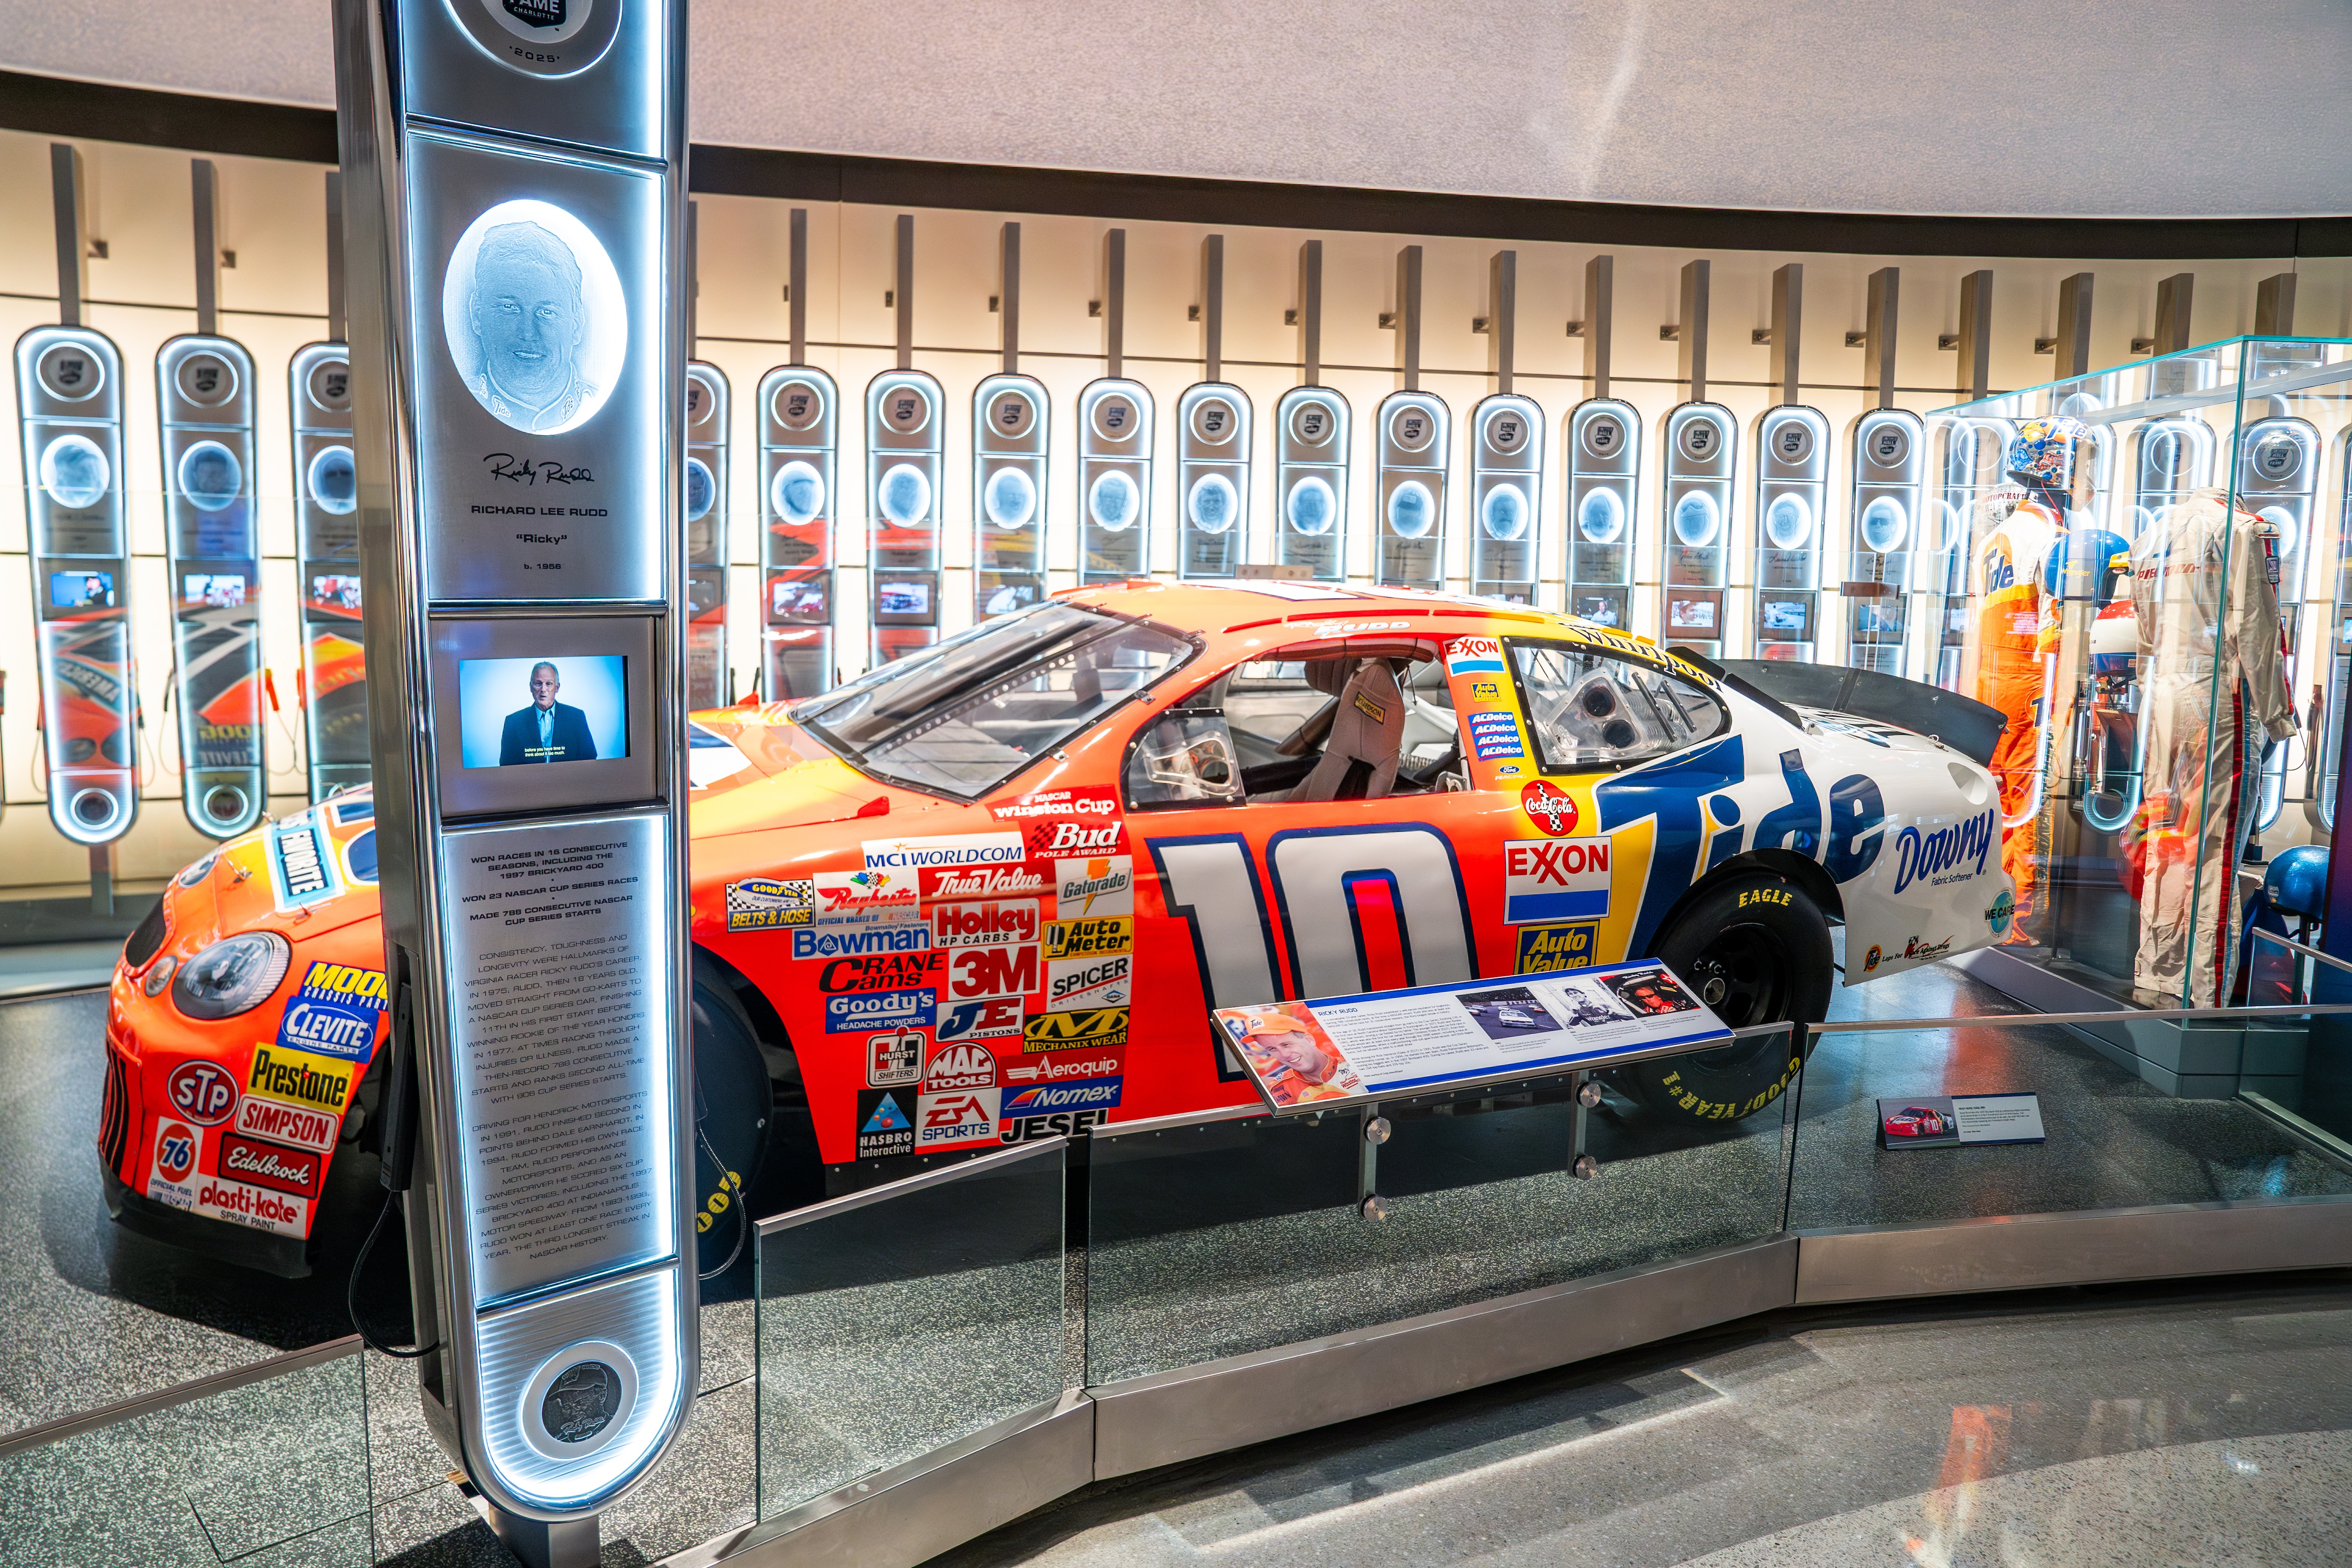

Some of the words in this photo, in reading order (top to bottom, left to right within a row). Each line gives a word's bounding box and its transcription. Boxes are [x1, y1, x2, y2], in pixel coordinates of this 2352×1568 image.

[510, 0, 559, 14] AME
[514, 7, 555, 20] CHARLOTTE
[471, 505, 535, 515] RICHARD
[540, 507, 565, 516] LEE
[1983, 546, 2014, 597] Tide
[1313, 621, 1411, 636] RUDD
[1447, 638, 1499, 657] EXXON
[1472, 713, 1513, 723] ACDelco
[1475, 724, 1517, 734] ACDelco
[1478, 735, 1519, 745] ACDelco
[1481, 746, 1522, 756] ACDelco
[1035, 792, 1071, 802] NASCAR
[994, 802, 1074, 818] Winston
[1075, 798, 1115, 815] Cup
[1049, 821, 1122, 849] Bud
[498, 852, 531, 862] RACES
[563, 842, 628, 854] CONSECUTIVE
[867, 853, 906, 868] MCI
[911, 847, 1022, 866] WORLDCOM
[1034, 850, 1069, 859] POLE
[1072, 847, 1117, 856] AWARD
[1596, 734, 1885, 962] Tide
[1894, 808, 1994, 895] Downy
[488, 860, 539, 872] SEASONS,
[542, 854, 593, 866] INCLUDING
[500, 871, 524, 880] 1997
[528, 864, 582, 876] BRICKYARD
[1507, 842, 1608, 886] EXXON
[505, 887, 547, 898] NASCAR
[572, 880, 604, 891] SERIES
[607, 876, 638, 885] RACES
[1063, 874, 1126, 899] Gatorade
[1931, 876, 1948, 887] Fabric
[1948, 873, 1973, 884] Softener
[470, 911, 499, 921] MADE
[524, 900, 591, 914] CONSECUTIVE
[594, 895, 633, 905] NASCAR
[1738, 888, 1793, 908] EAGLE
[528, 913, 562, 923] SERIES
[565, 908, 601, 918] STARTS
[731, 911, 766, 927] BELTS
[767, 911, 777, 924] &
[779, 908, 812, 924] HOSE
[938, 903, 1035, 941] Holley
[1985, 908, 1996, 921] WE
[1997, 904, 2015, 918] CARE
[1068, 920, 1121, 937] Auto
[939, 936, 957, 946] HP
[963, 932, 1009, 944] CARBS
[1064, 934, 1130, 956] Meter
[1527, 928, 1587, 955] Auto
[1144, 821, 1480, 1082] 10
[1863, 949, 1881, 972] Tide
[952, 945, 1038, 997] 3M
[1524, 955, 1588, 975] Value
[304, 962, 388, 1000] MOO
[1052, 957, 1129, 997] SPICER
[304, 986, 353, 1005] CHASSIS
[829, 991, 934, 1015] Goody's
[1051, 979, 1128, 1008] DRIVESHAFTS
[286, 1003, 369, 1047] CLEVITE
[836, 1021, 882, 1031] HEADACHE
[884, 1017, 926, 1027] POWDERS
[938, 997, 1021, 1040] JE
[1250, 1019, 1263, 1029] Tide
[1585, 1014, 1611, 1025] Wrangler
[969, 1028, 1020, 1038] PISTONS
[1024, 1041, 1089, 1053] MECHANIX
[1090, 1032, 1127, 1046] WEAR
[289, 1037, 324, 1048] ENGINE
[326, 1043, 358, 1054] PARTS
[879, 1050, 916, 1061] HURST
[928, 1046, 992, 1078] MAC
[1036, 1055, 1118, 1079] Aeroquip
[251, 1049, 348, 1107] Prestone
[878, 1069, 914, 1080] SHIFTERS
[929, 1074, 992, 1089] TOOLS
[176, 1068, 230, 1116] STP
[1033, 1084, 1119, 1107] Nomex
[243, 1102, 330, 1145] SIMPSON
[922, 1122, 990, 1140] SPORTS
[1930, 1119, 1939, 1131] 10
[860, 1132, 912, 1147] HASBRO
[159, 1138, 192, 1171] 76
[860, 1144, 911, 1158] Interactive
[228, 1146, 310, 1185] Edelbrock
[151, 1178, 175, 1192] OFFICIAL
[177, 1186, 193, 1196] FUEL
[199, 1180, 298, 1223] plasti-kote
[220, 1210, 248, 1224] SPRAY
[250, 1218, 276, 1231] PAINT
[530, 1246, 568, 1260] NASCAR
